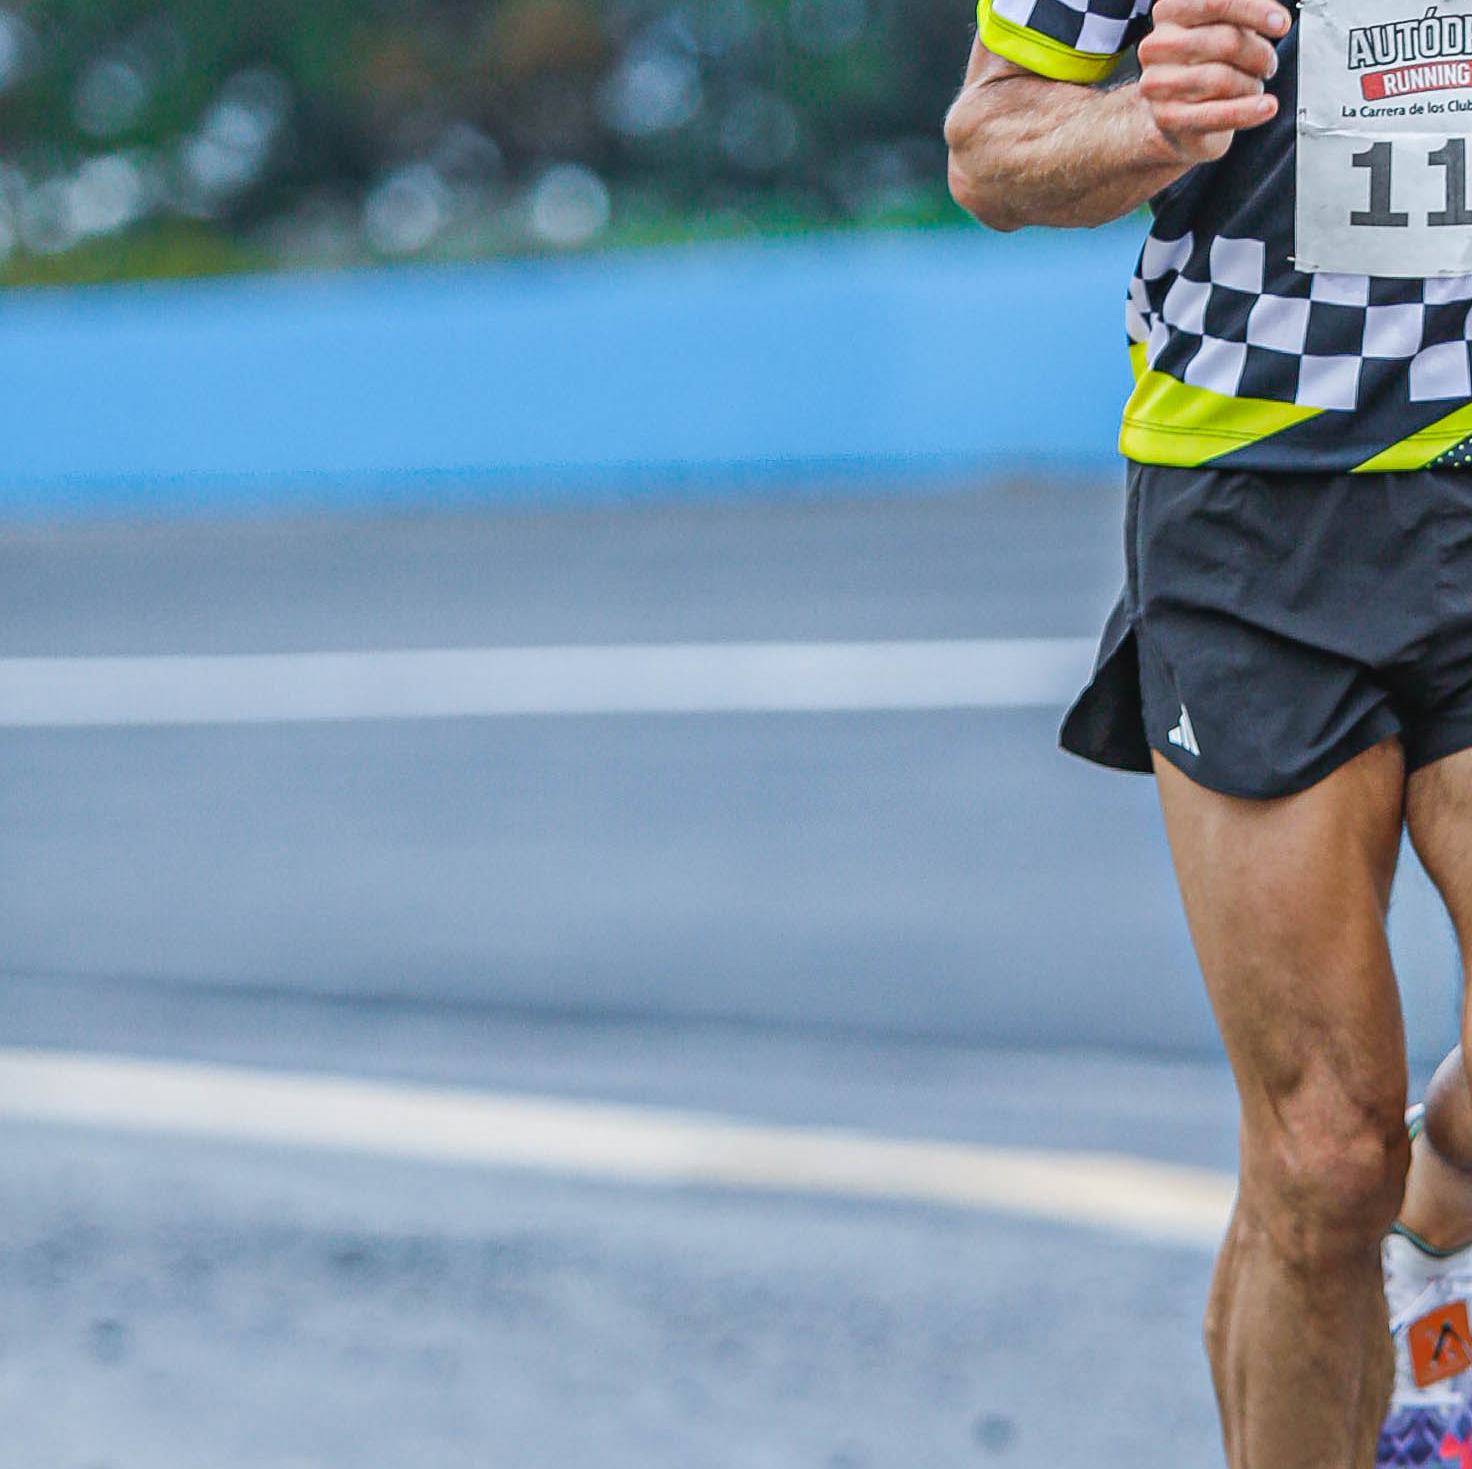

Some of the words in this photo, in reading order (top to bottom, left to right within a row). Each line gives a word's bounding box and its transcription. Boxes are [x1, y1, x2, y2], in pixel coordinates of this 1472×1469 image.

[1382, 63, 1471, 96] RUNNING
[1341, 105, 1357, 117] La
[1359, 105, 1406, 118] Carrera
[1408, 100, 1424, 115] de
[1427, 100, 1445, 114] los
